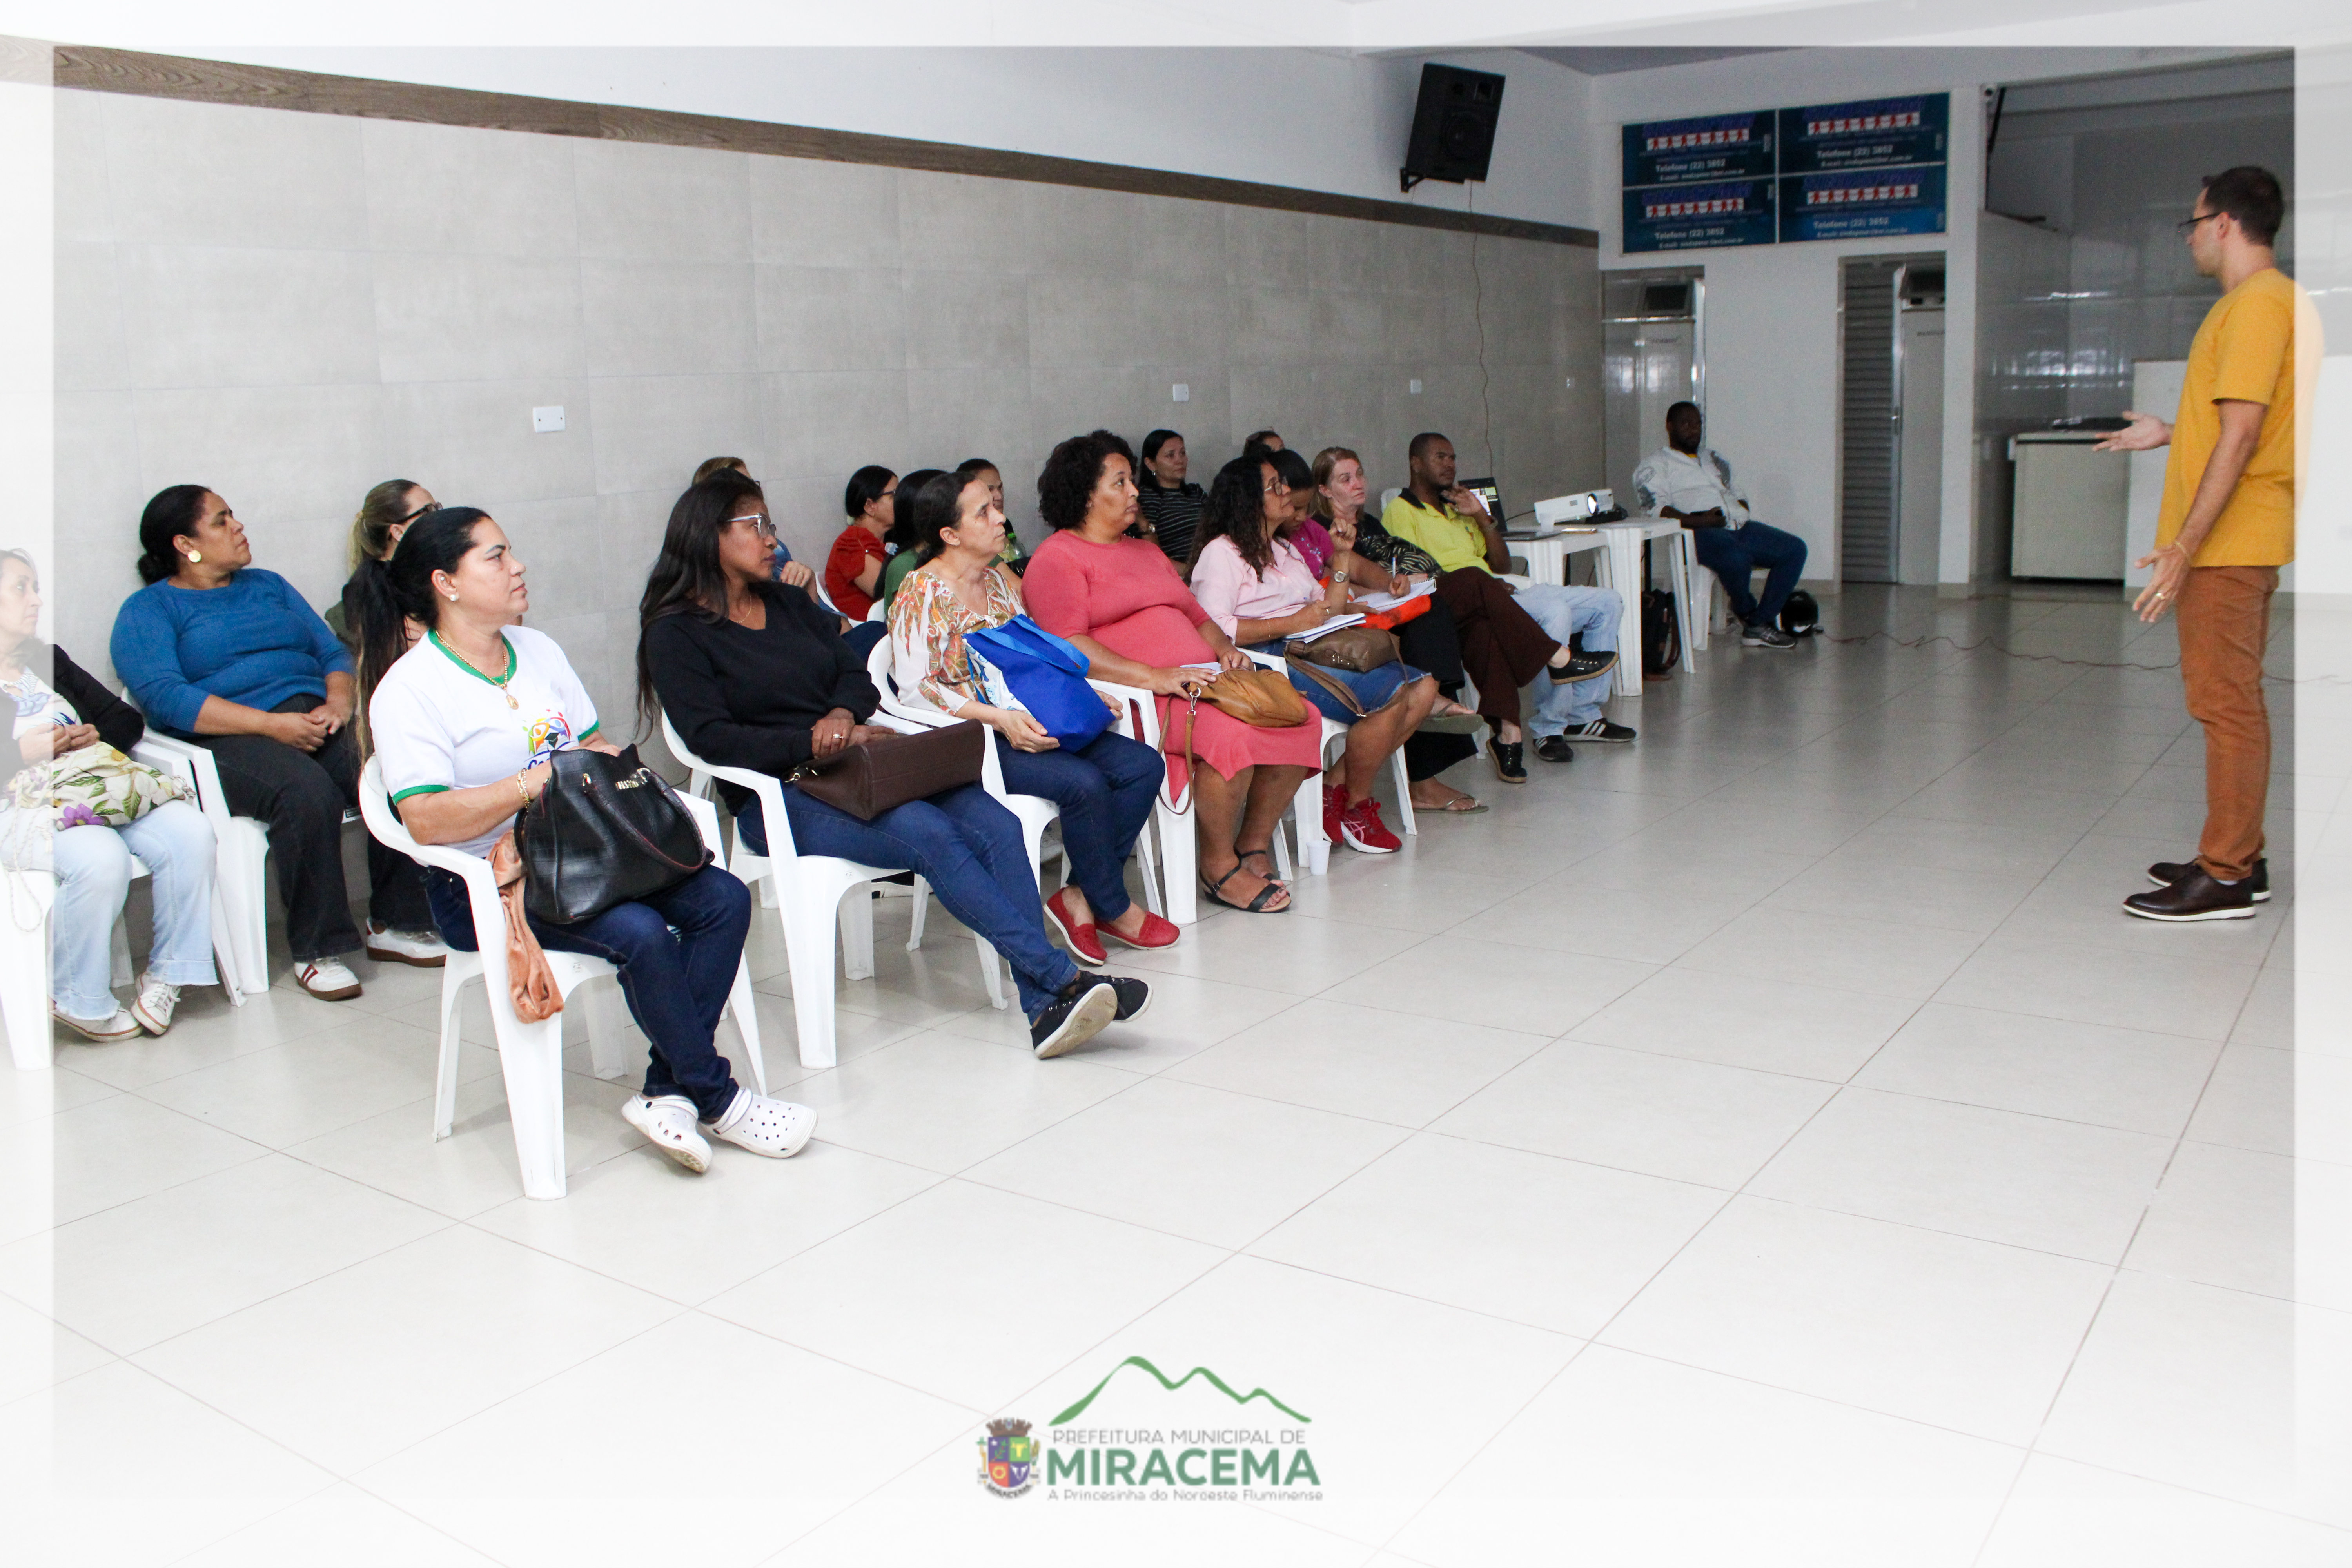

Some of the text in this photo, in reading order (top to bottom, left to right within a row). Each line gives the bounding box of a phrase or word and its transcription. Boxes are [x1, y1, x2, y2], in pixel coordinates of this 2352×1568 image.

[1817, 149, 1851, 158] Telefone
[1656, 163, 1688, 172] Telefone
[1813, 220, 1848, 229] Telefone
[1655, 231, 1687, 240] Telefone
